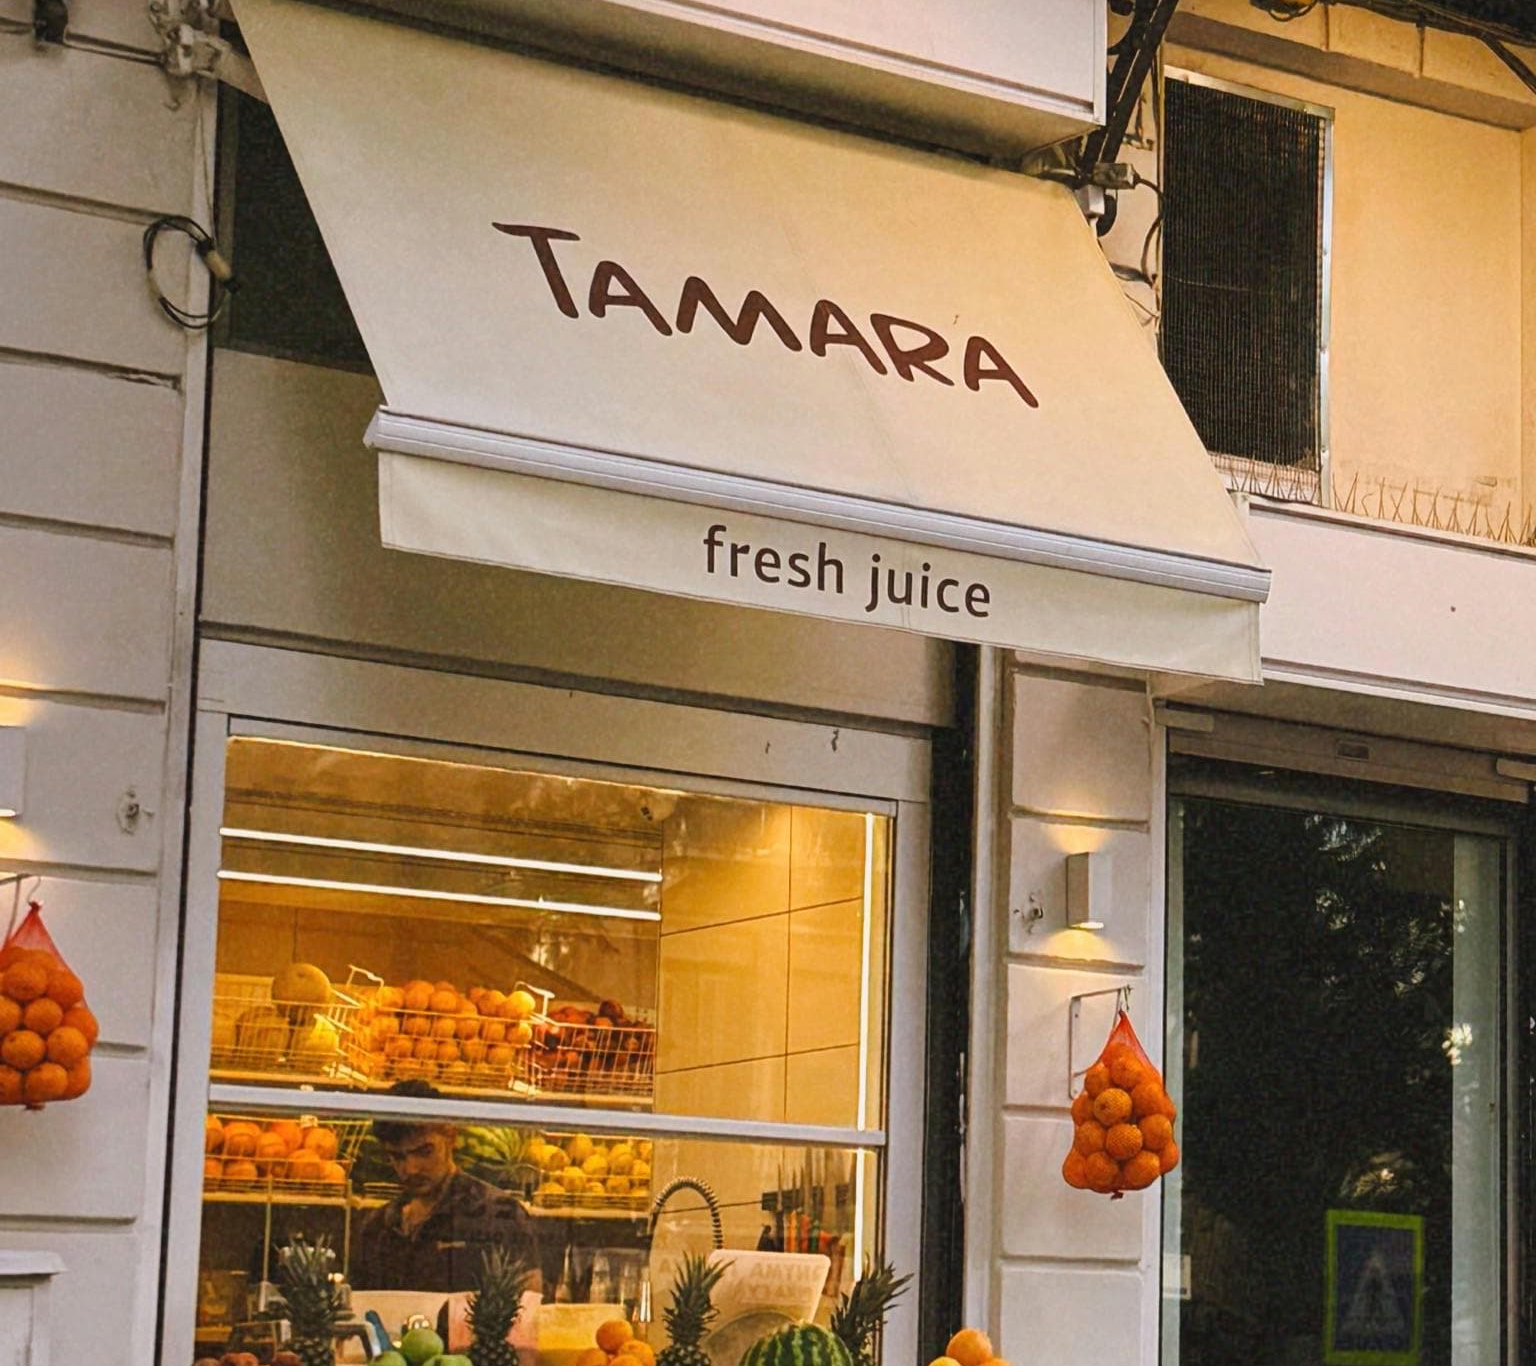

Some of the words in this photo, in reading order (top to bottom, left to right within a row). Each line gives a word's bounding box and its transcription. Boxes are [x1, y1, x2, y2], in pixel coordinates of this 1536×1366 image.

[491, 221, 1039, 409] TAMARA
[703, 524, 845, 595] fresh
[866, 552, 992, 618] juice
